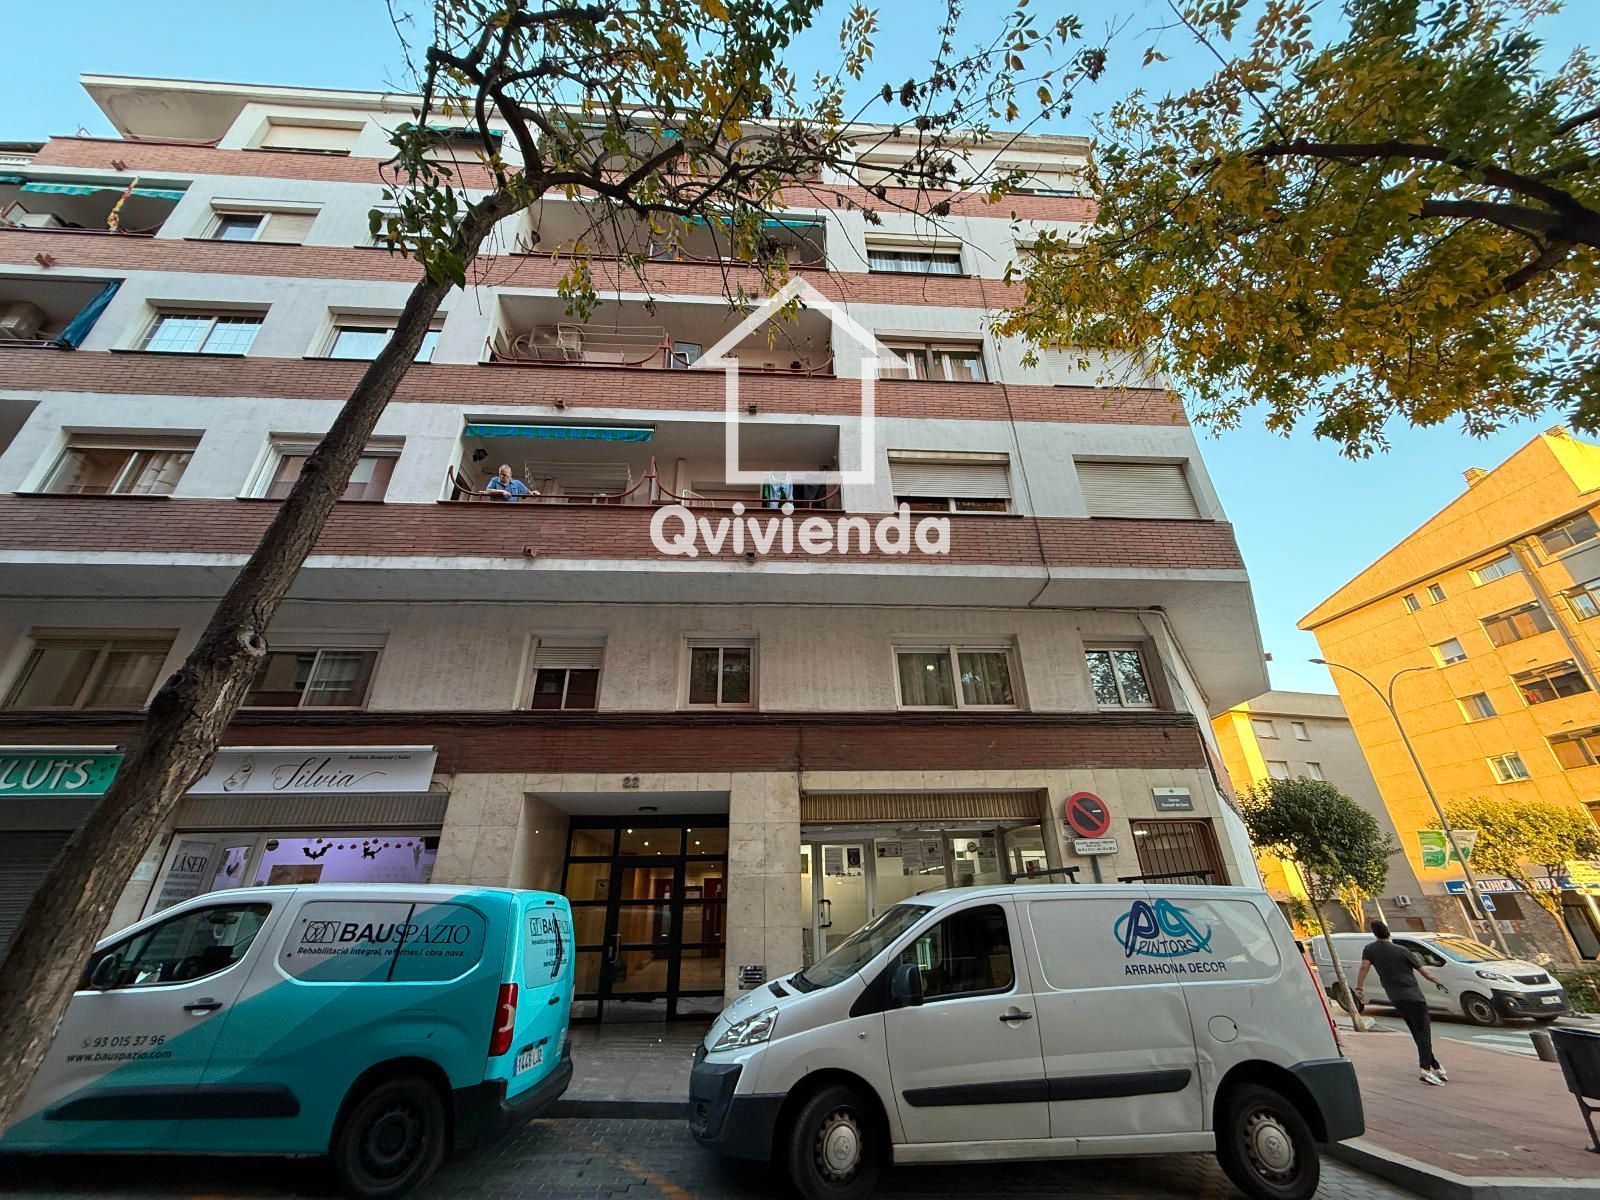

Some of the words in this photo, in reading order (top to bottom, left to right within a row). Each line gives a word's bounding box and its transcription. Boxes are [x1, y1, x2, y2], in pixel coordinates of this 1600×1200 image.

[271, 756, 388, 791] Silvia
[623, 775, 640, 788] 22
[338, 923, 471, 945] BAUSPAZIO
[297, 947, 349, 955] Rehabilitació
[424, 949, 443, 957] obra
[1136, 939, 1200, 955] PINTORS
[1125, 963, 1187, 976] ARRAHONA
[1187, 961, 1228, 974] DECOR
[93, 1036, 109, 1048] 93
[110, 1036, 132, 1047] 015
[132, 1035, 149, 1047] 37
[149, 1034, 166, 1046] 96
[66, 1050, 173, 1062] www.bauspazio.com
